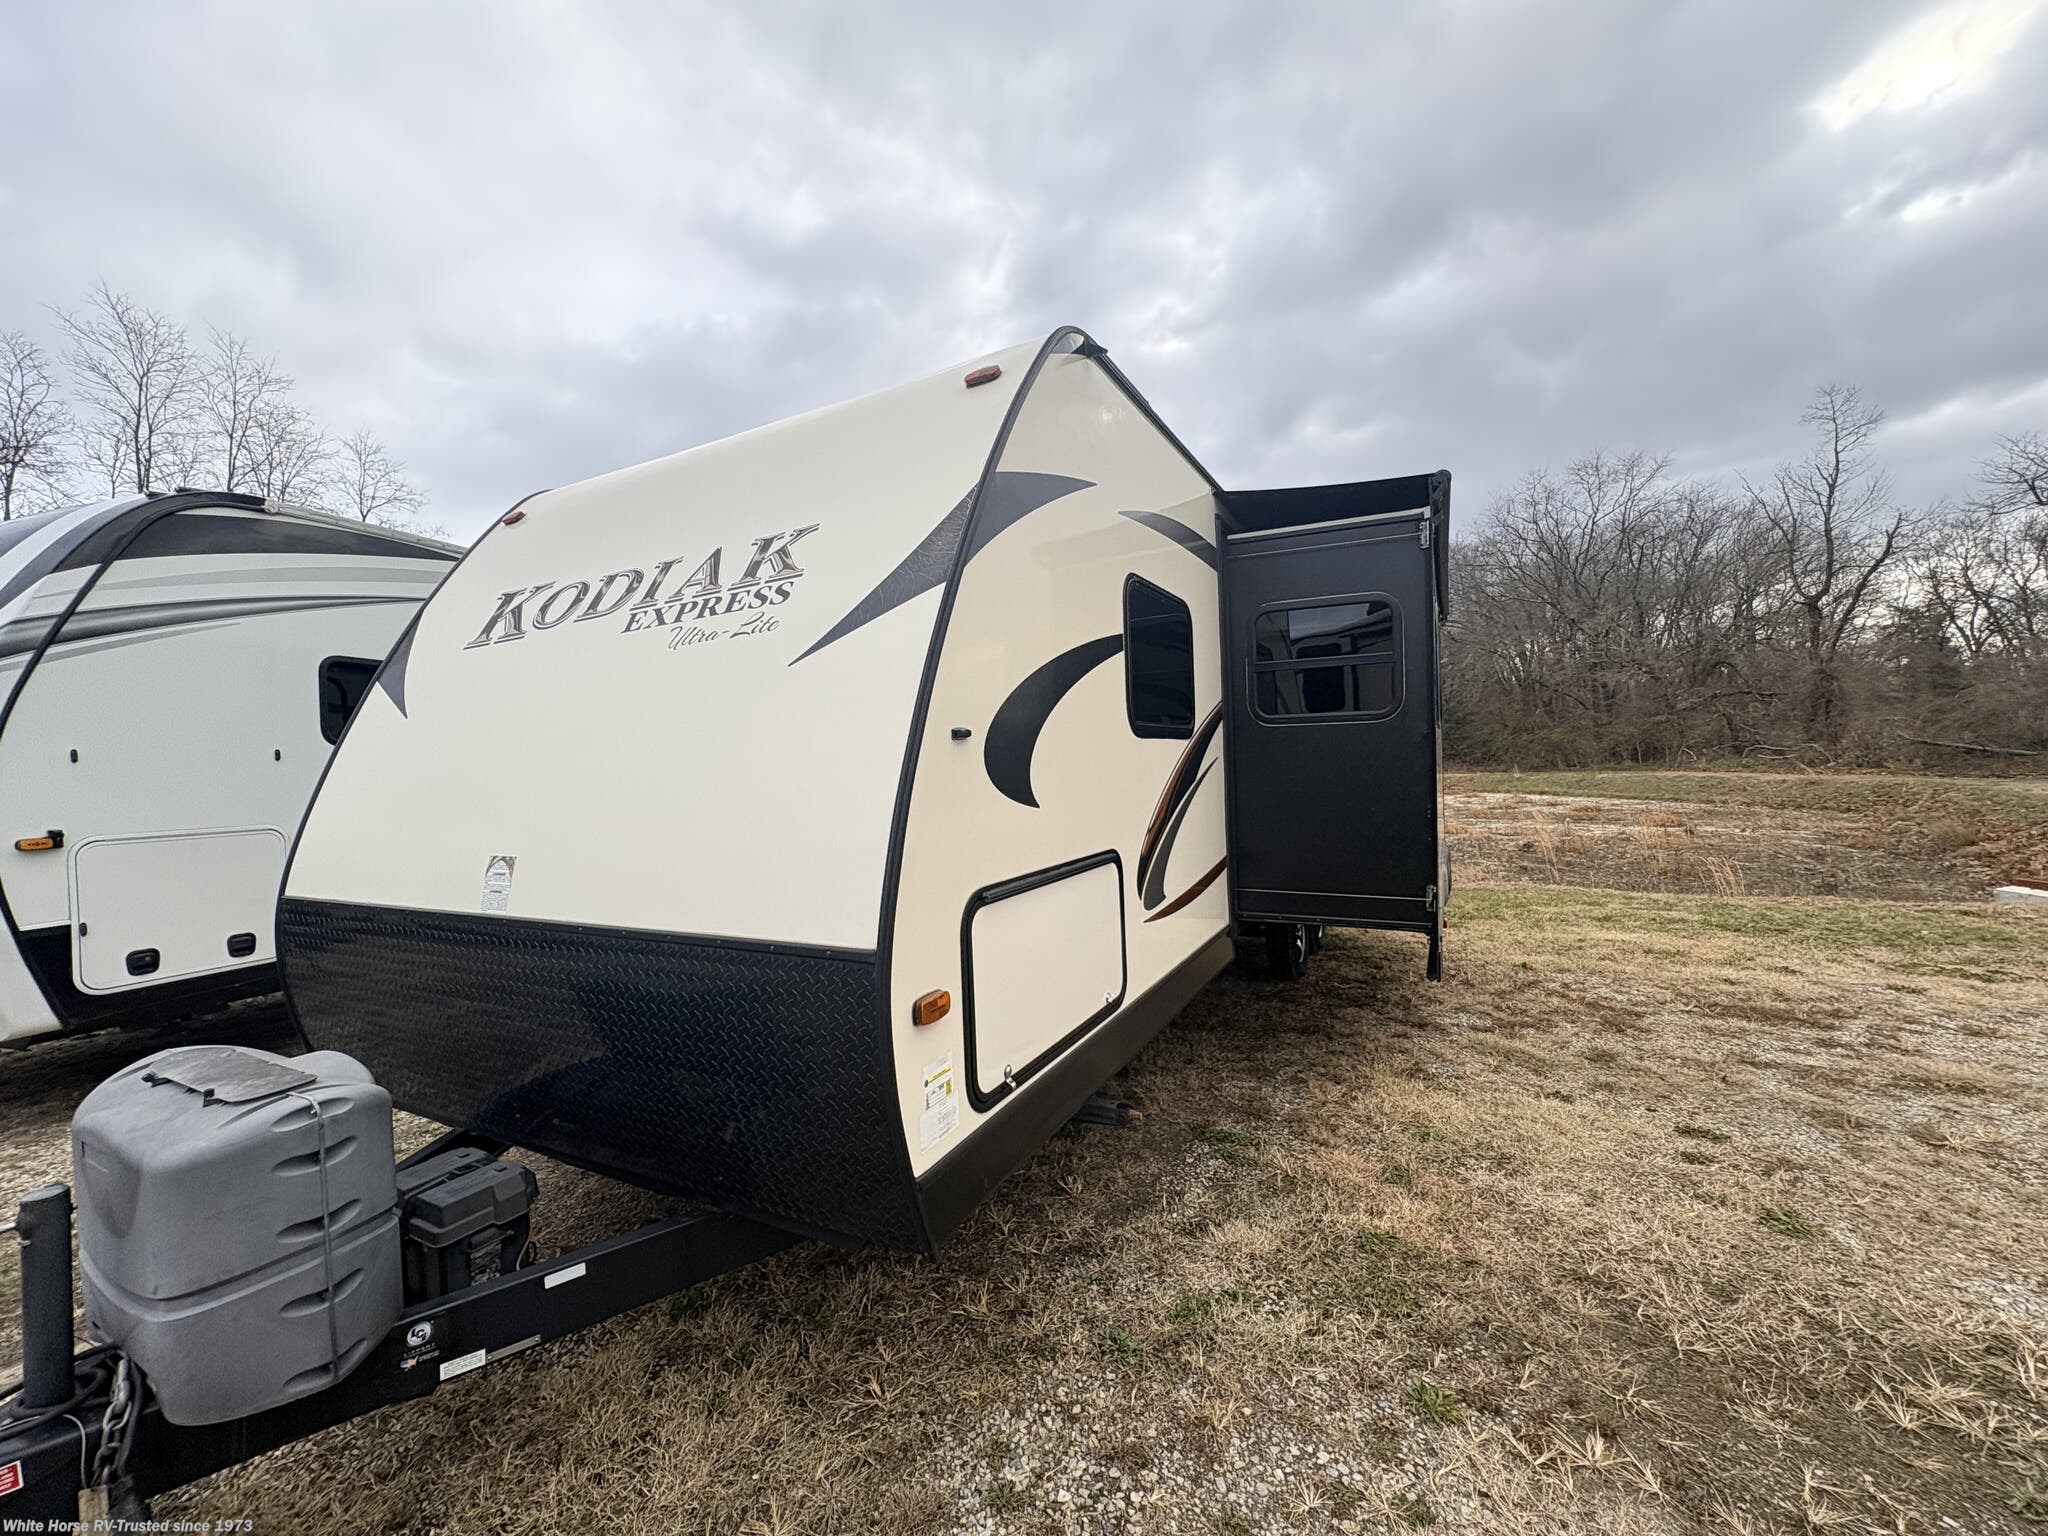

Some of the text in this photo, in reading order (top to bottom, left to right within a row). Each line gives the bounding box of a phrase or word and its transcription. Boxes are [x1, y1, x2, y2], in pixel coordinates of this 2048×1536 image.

[463, 523, 820, 650] KODIAK
[620, 580, 795, 634] EXPRESS
[667, 611, 780, 651] Ultra-Lite
